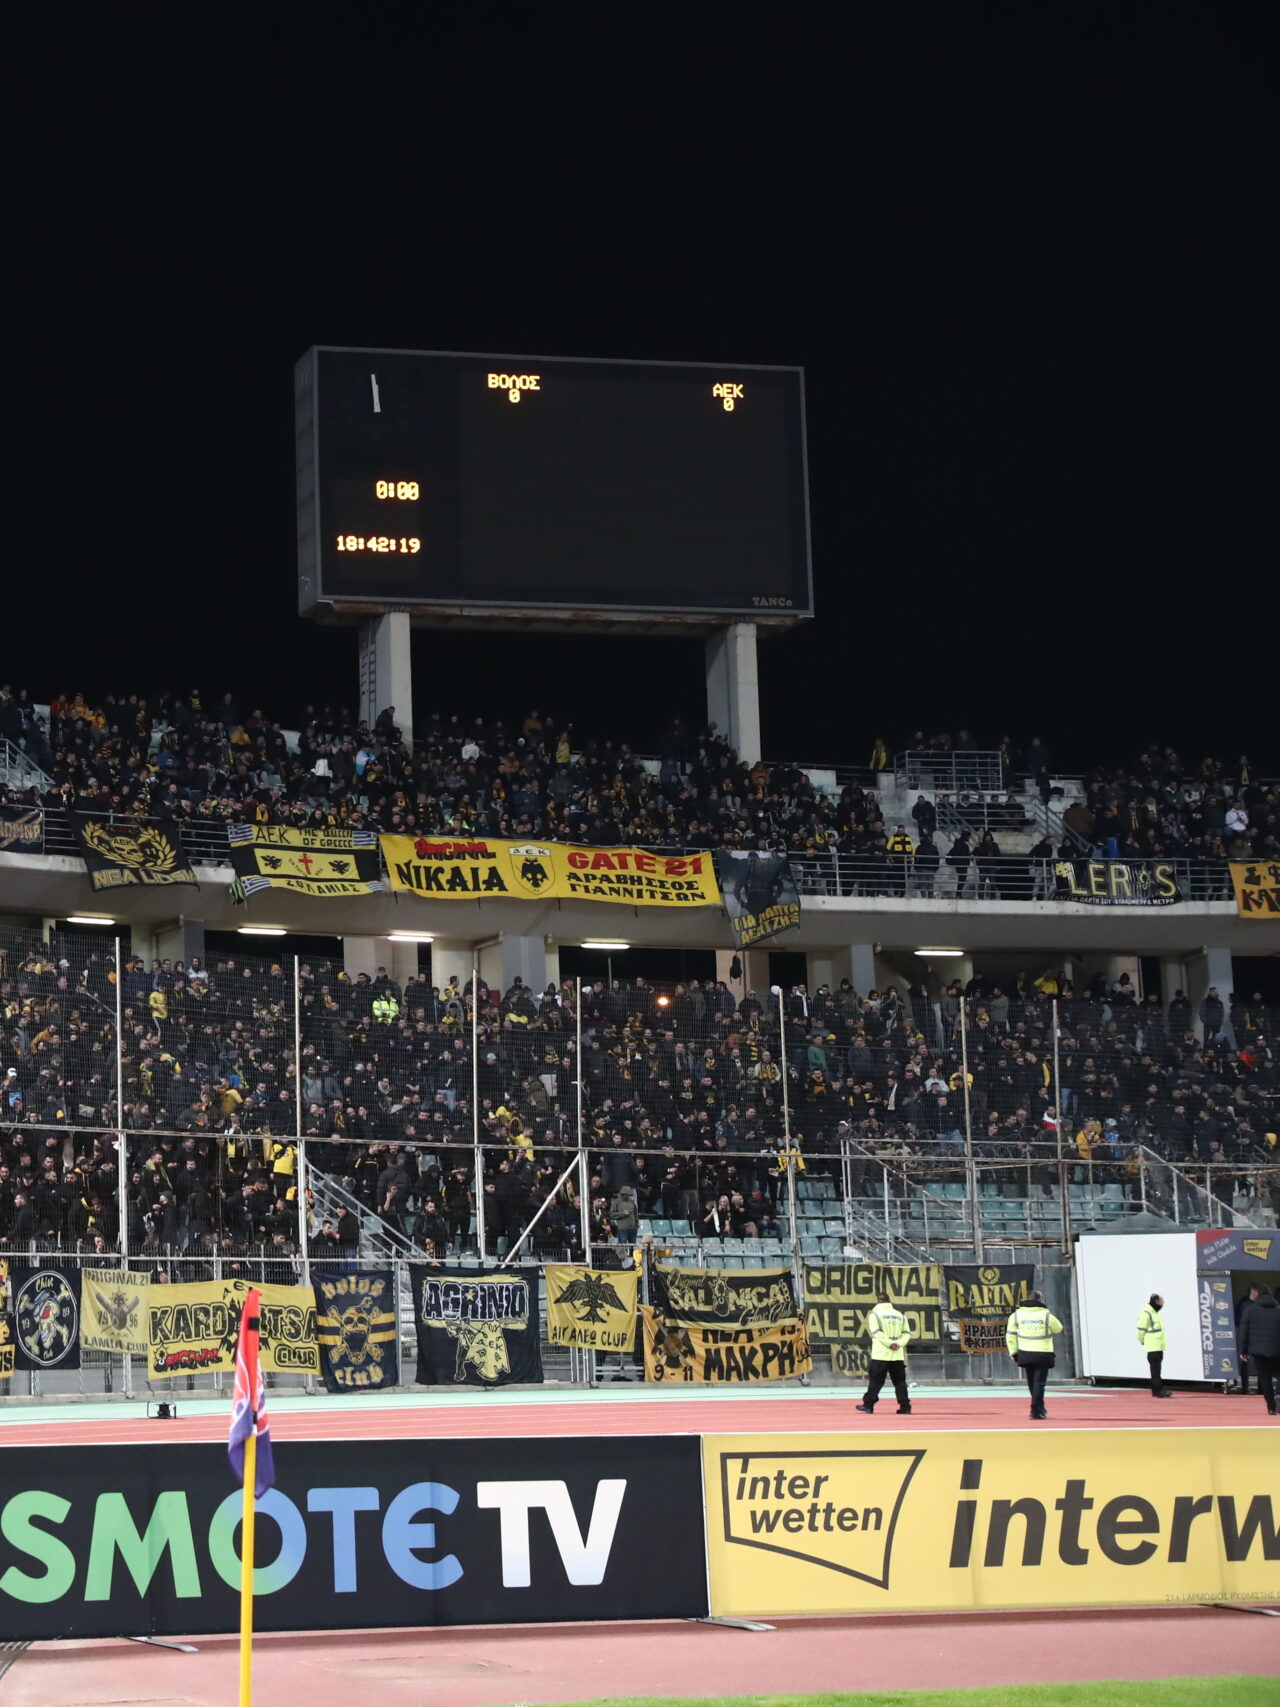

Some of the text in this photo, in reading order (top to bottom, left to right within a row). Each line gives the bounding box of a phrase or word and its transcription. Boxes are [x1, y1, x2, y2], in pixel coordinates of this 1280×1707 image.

[508, 388, 520, 403] 0
[712, 383, 744, 398] ΑΕΚ
[723, 397, 734, 411] 0
[376, 480, 419, 500] 0:00
[336, 535, 420, 553] 18:42:19
[256, 827, 291, 844] AEK
[320, 838, 354, 848] GREECE
[567, 852, 703, 876] GATE 21
[806, 1264, 940, 1297] ORIGINAL
[424, 1281, 527, 1320] AGRINIO
[949, 1280, 1028, 1311] RAFINA
[275, 1345, 318, 1368] CLUB
[736, 1458, 829, 1500] inter
[749, 1500, 883, 1533] wetten
[477, 1479, 628, 1587] TV
